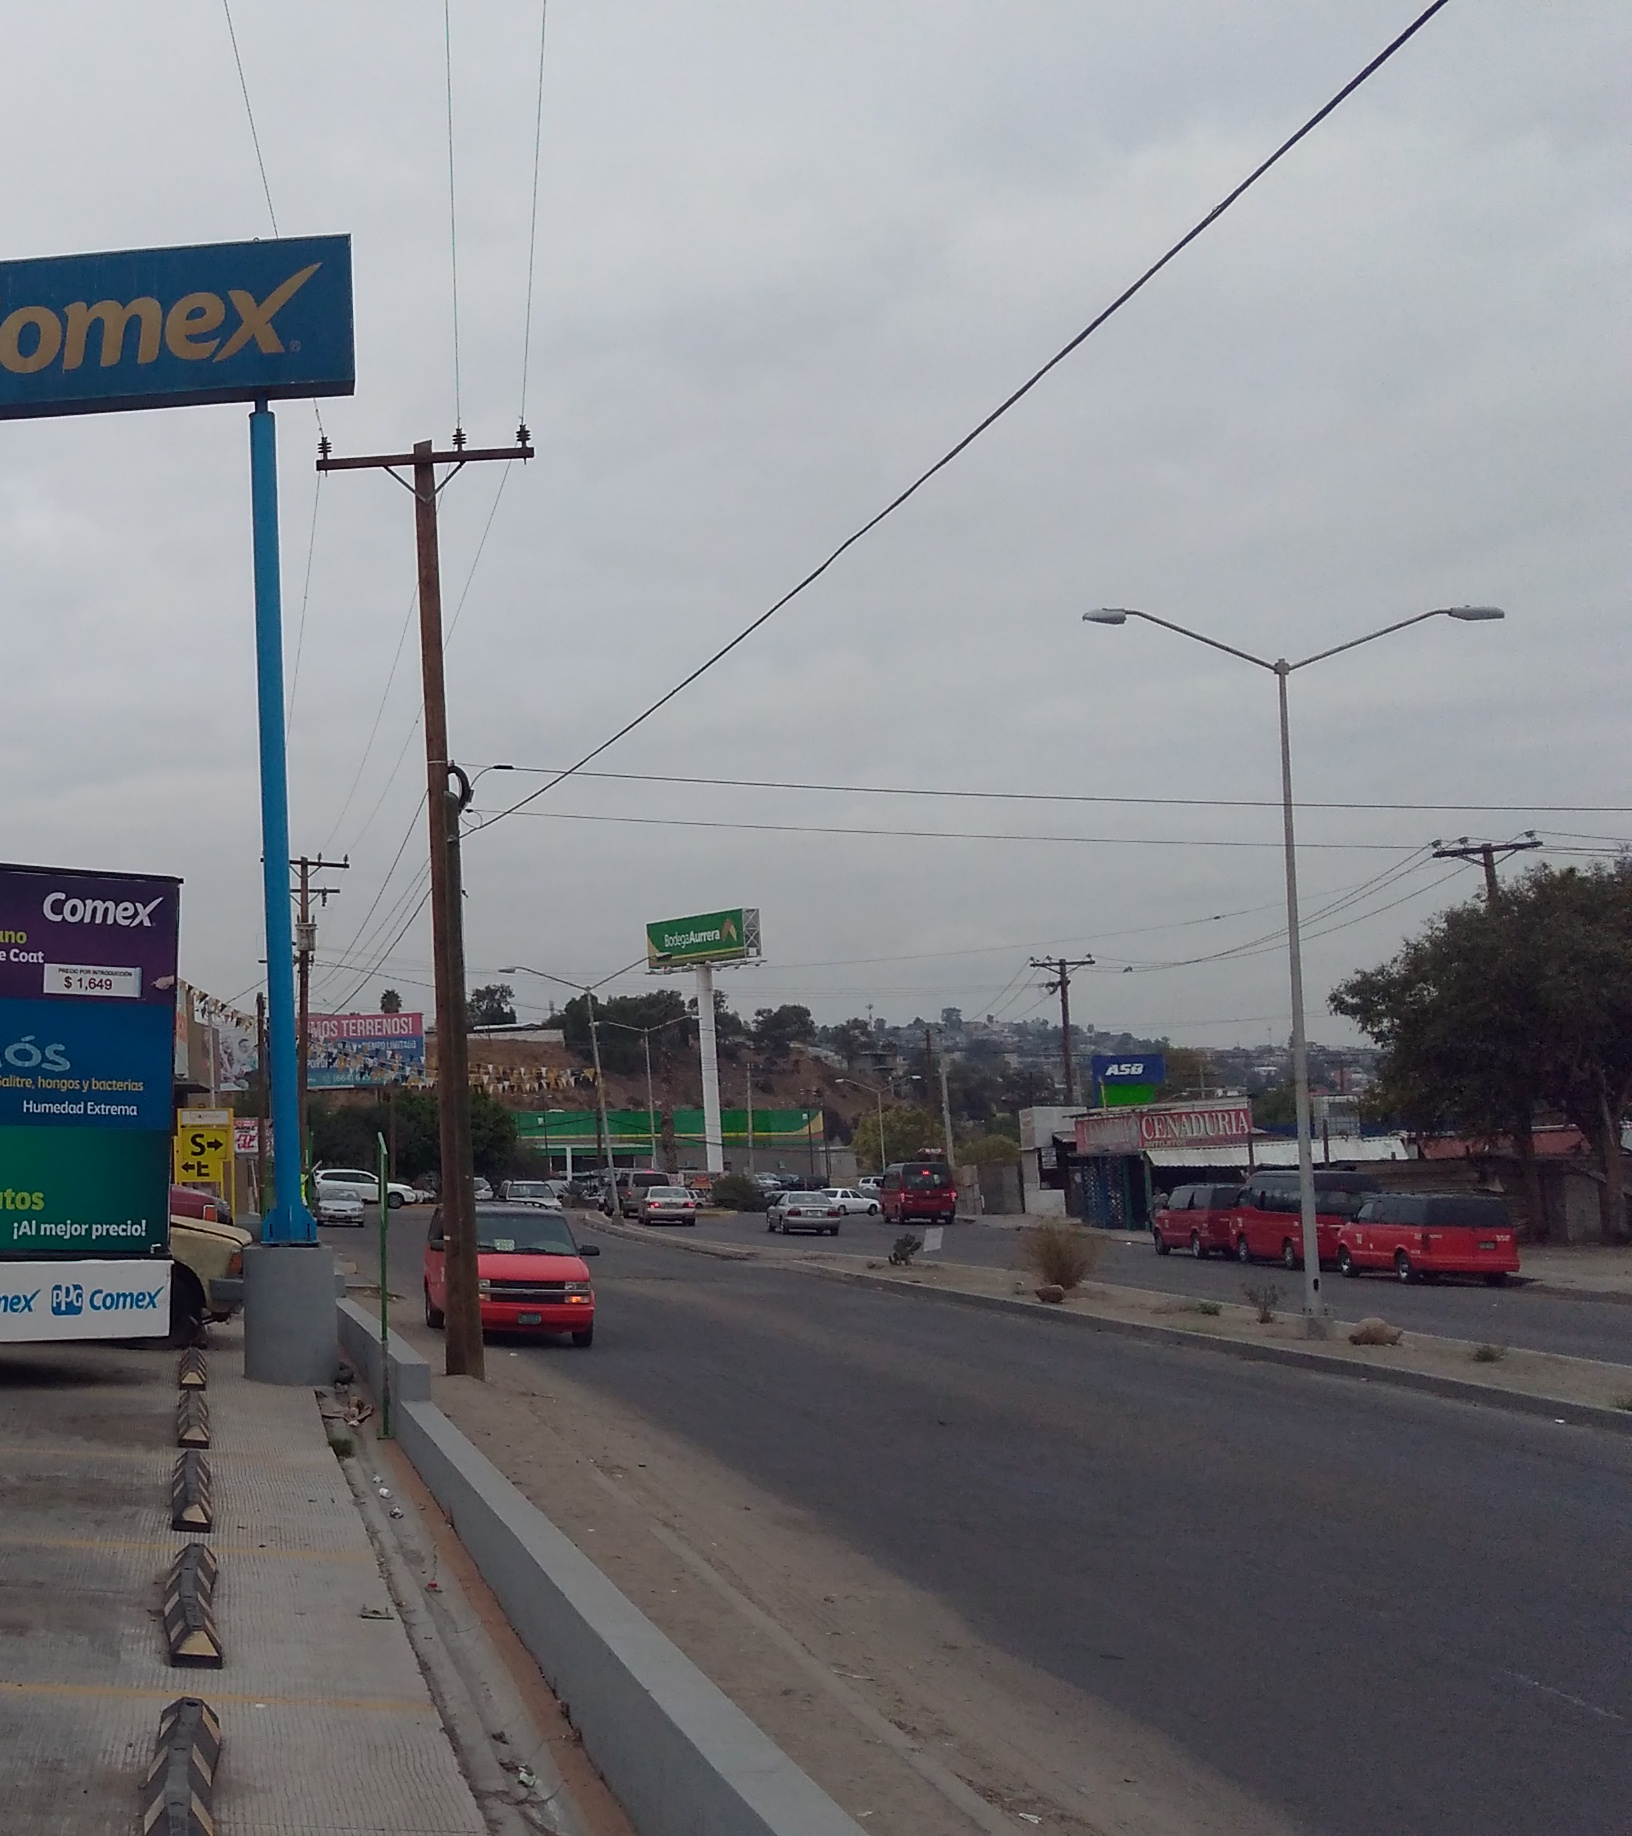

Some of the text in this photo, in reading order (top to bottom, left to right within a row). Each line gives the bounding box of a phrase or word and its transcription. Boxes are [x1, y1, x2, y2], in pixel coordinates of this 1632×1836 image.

[42, 891, 164, 927] Comex
[9, 948, 45, 964] Coat
[77, 977, 113, 991] 1,649
[341, 1017, 413, 1037] TERRENOS!
[1105, 1063, 1145, 1076] ASB
[38, 1076, 81, 1092] hongos
[81, 1080, 91, 1093] y
[91, 1078, 145, 1092] bacterias
[23, 1099, 139, 1117] Humedad Extrema
[1141, 1111, 1250, 1140] CENADURIA
[190, 1133, 206, 1157] S
[13, 1218, 148, 1239] ¡Al mejor precio!
[52, 1283, 84, 1314] PPG
[89, 1286, 166, 1312] Comex
